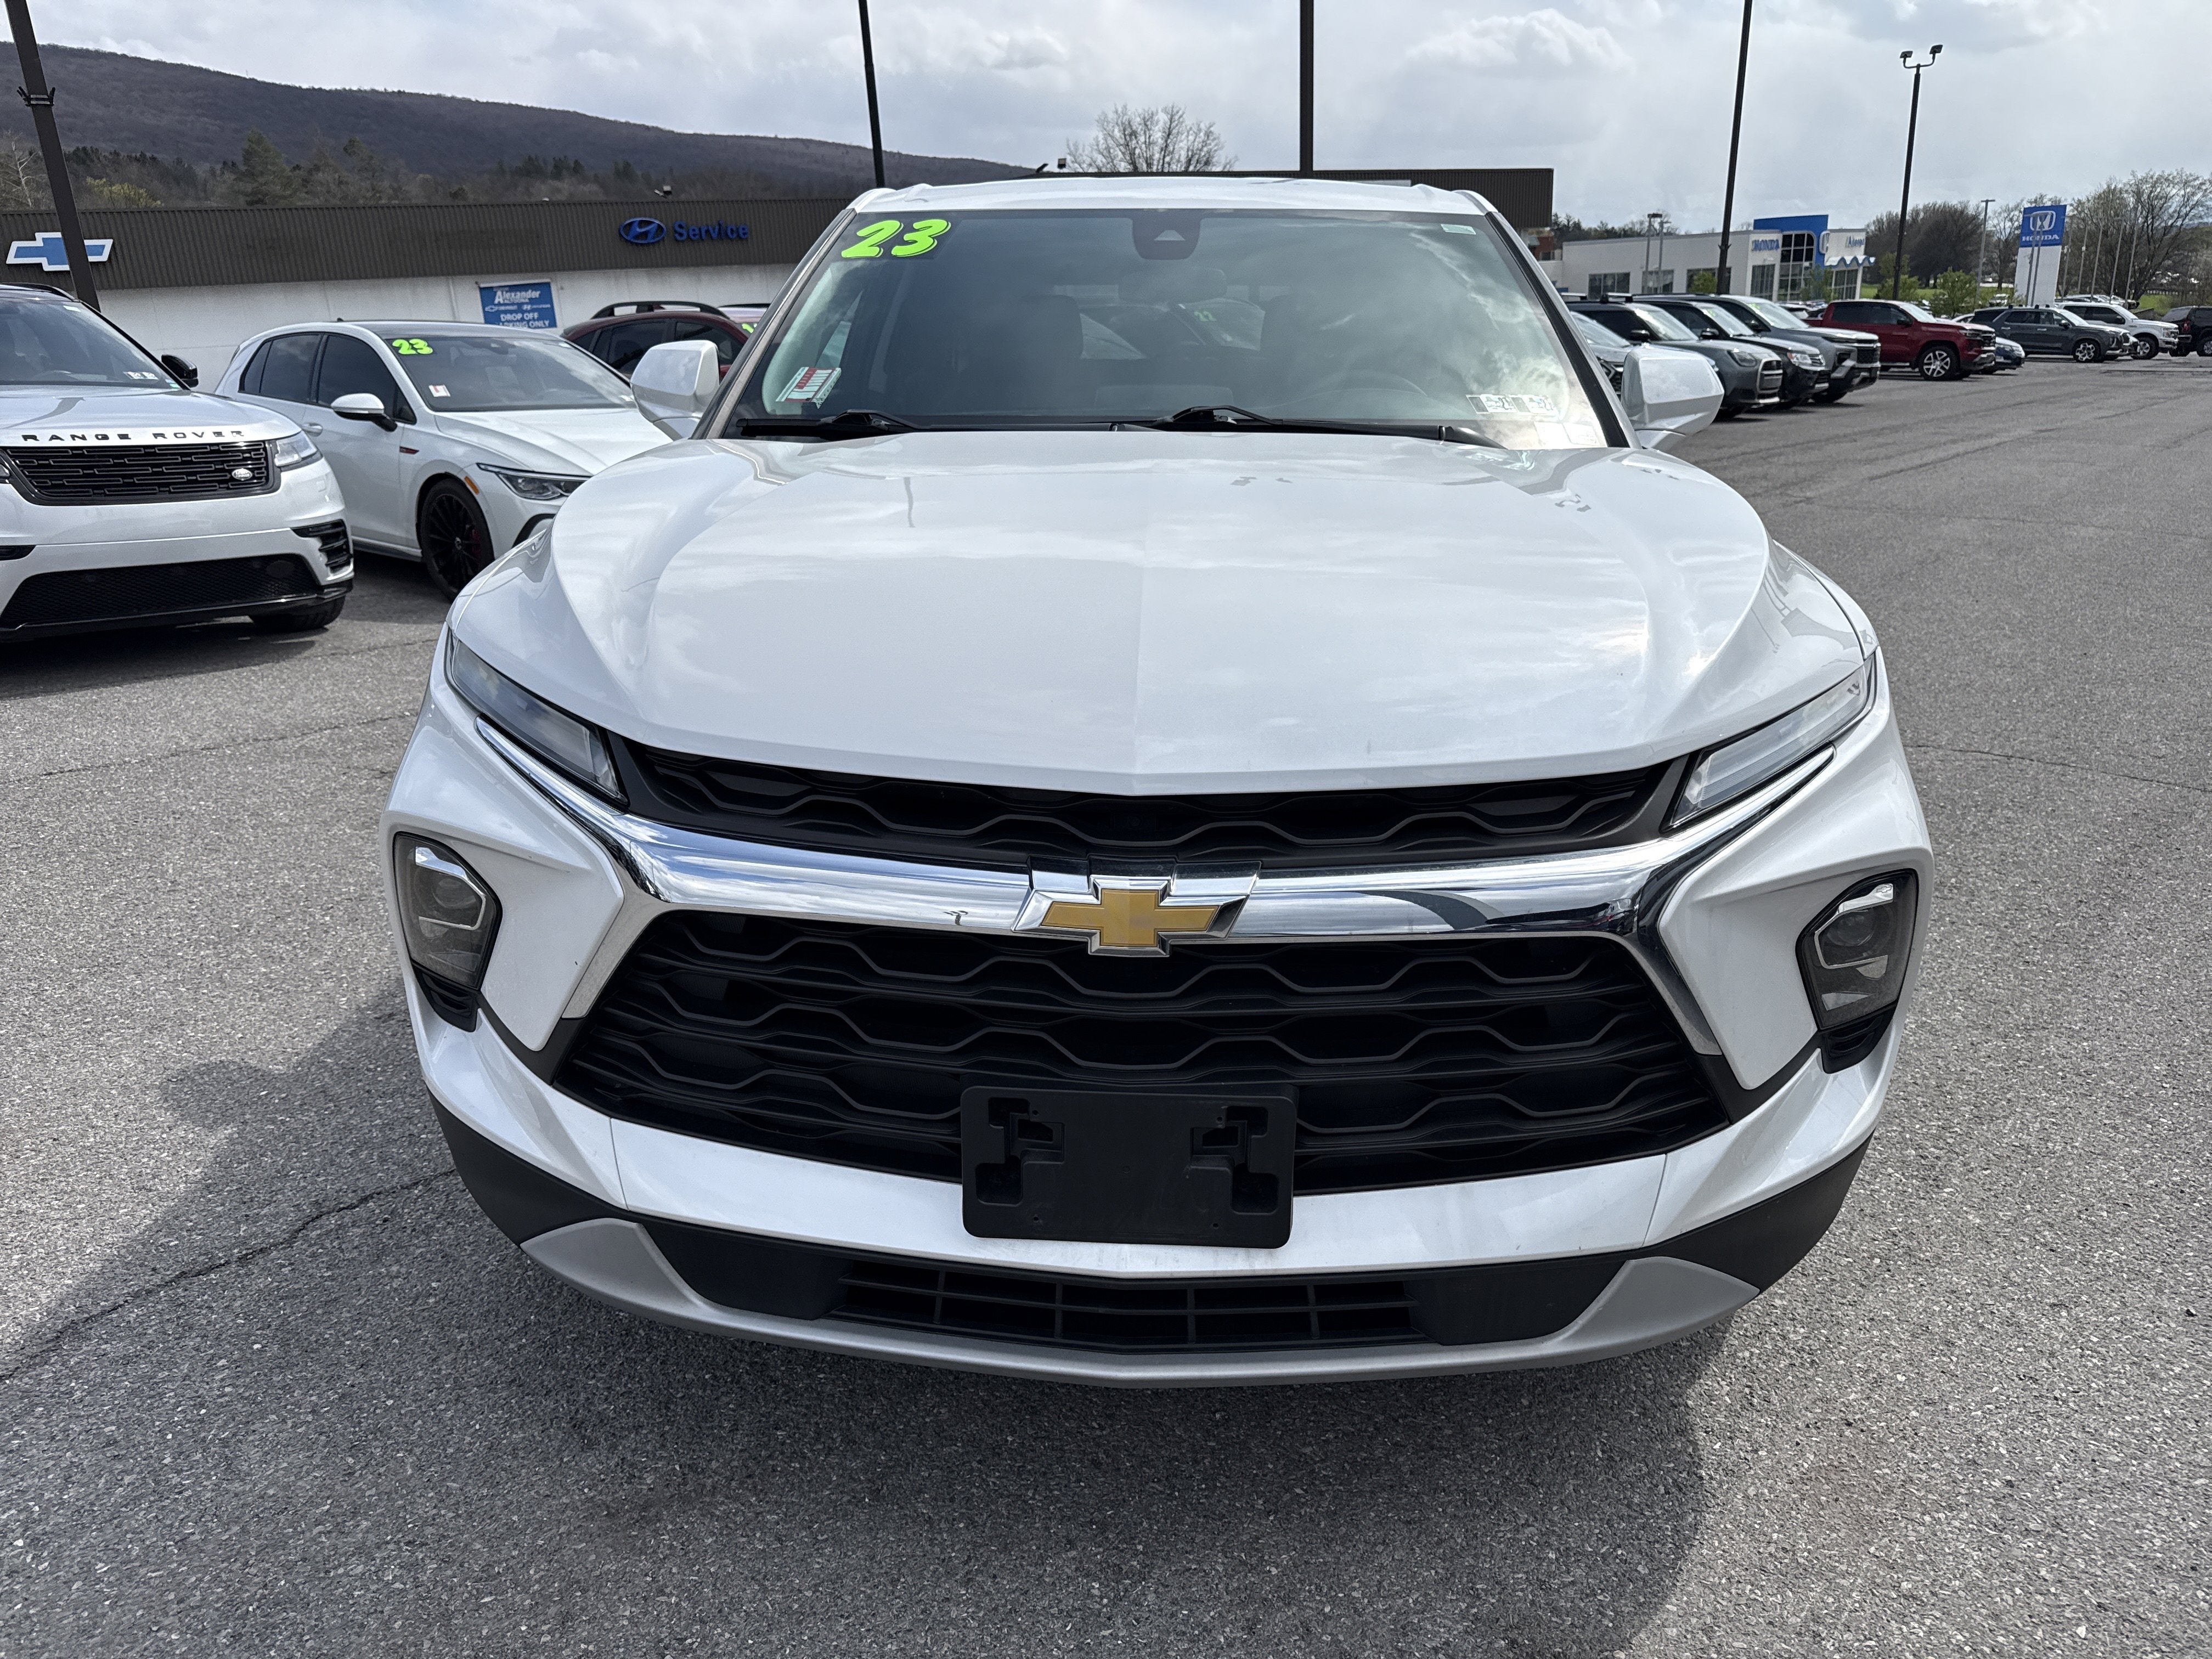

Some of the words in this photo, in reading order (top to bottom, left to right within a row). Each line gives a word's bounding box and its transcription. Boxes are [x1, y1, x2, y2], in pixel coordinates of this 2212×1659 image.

[673, 219, 749, 241] Service
[841, 219, 951, 258] 23
[494, 290, 540, 304] Alexander
[500, 313, 522, 321] DROP
[523, 312, 539, 320] OFF
[529, 320, 549, 328] ONLY
[392, 338, 433, 354] 23
[152, 431, 244, 439] ROVER
